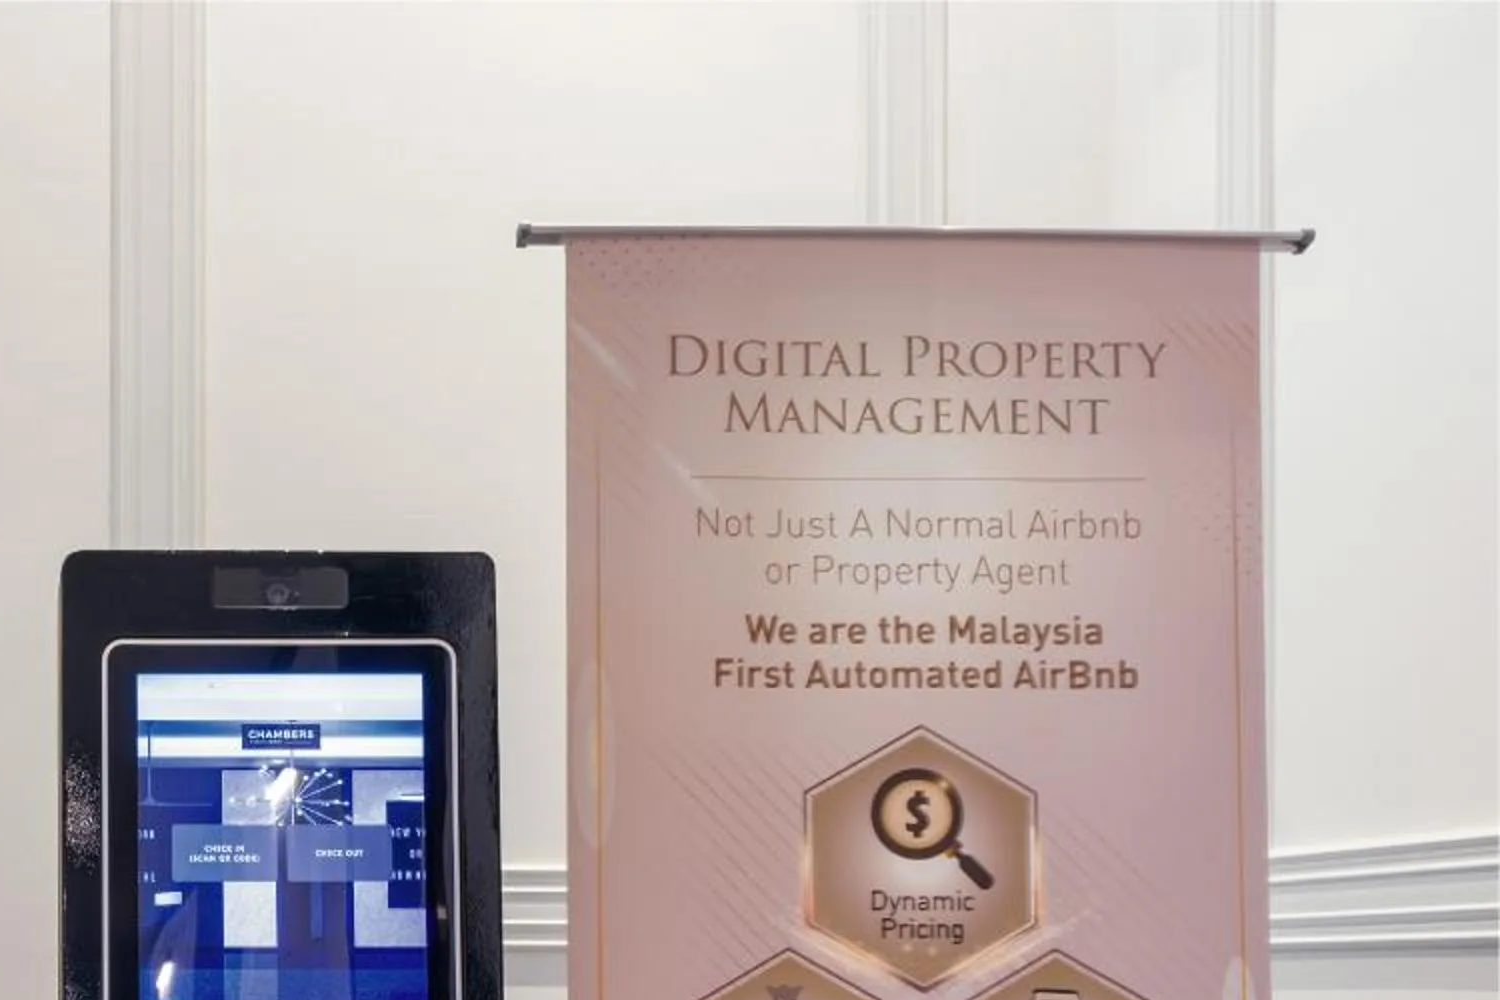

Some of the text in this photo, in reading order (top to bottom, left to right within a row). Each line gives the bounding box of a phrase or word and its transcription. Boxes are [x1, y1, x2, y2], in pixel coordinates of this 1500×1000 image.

[696, 506, 1141, 541] Not Just A Normal Airbnb
[765, 555, 1070, 594] or Property Agent
[745, 614, 1103, 652] We are the Malaysia
[713, 658, 1139, 691] First Automated AirBnb
[871, 891, 975, 917] Dynamic
[881, 919, 965, 944] Pricing
